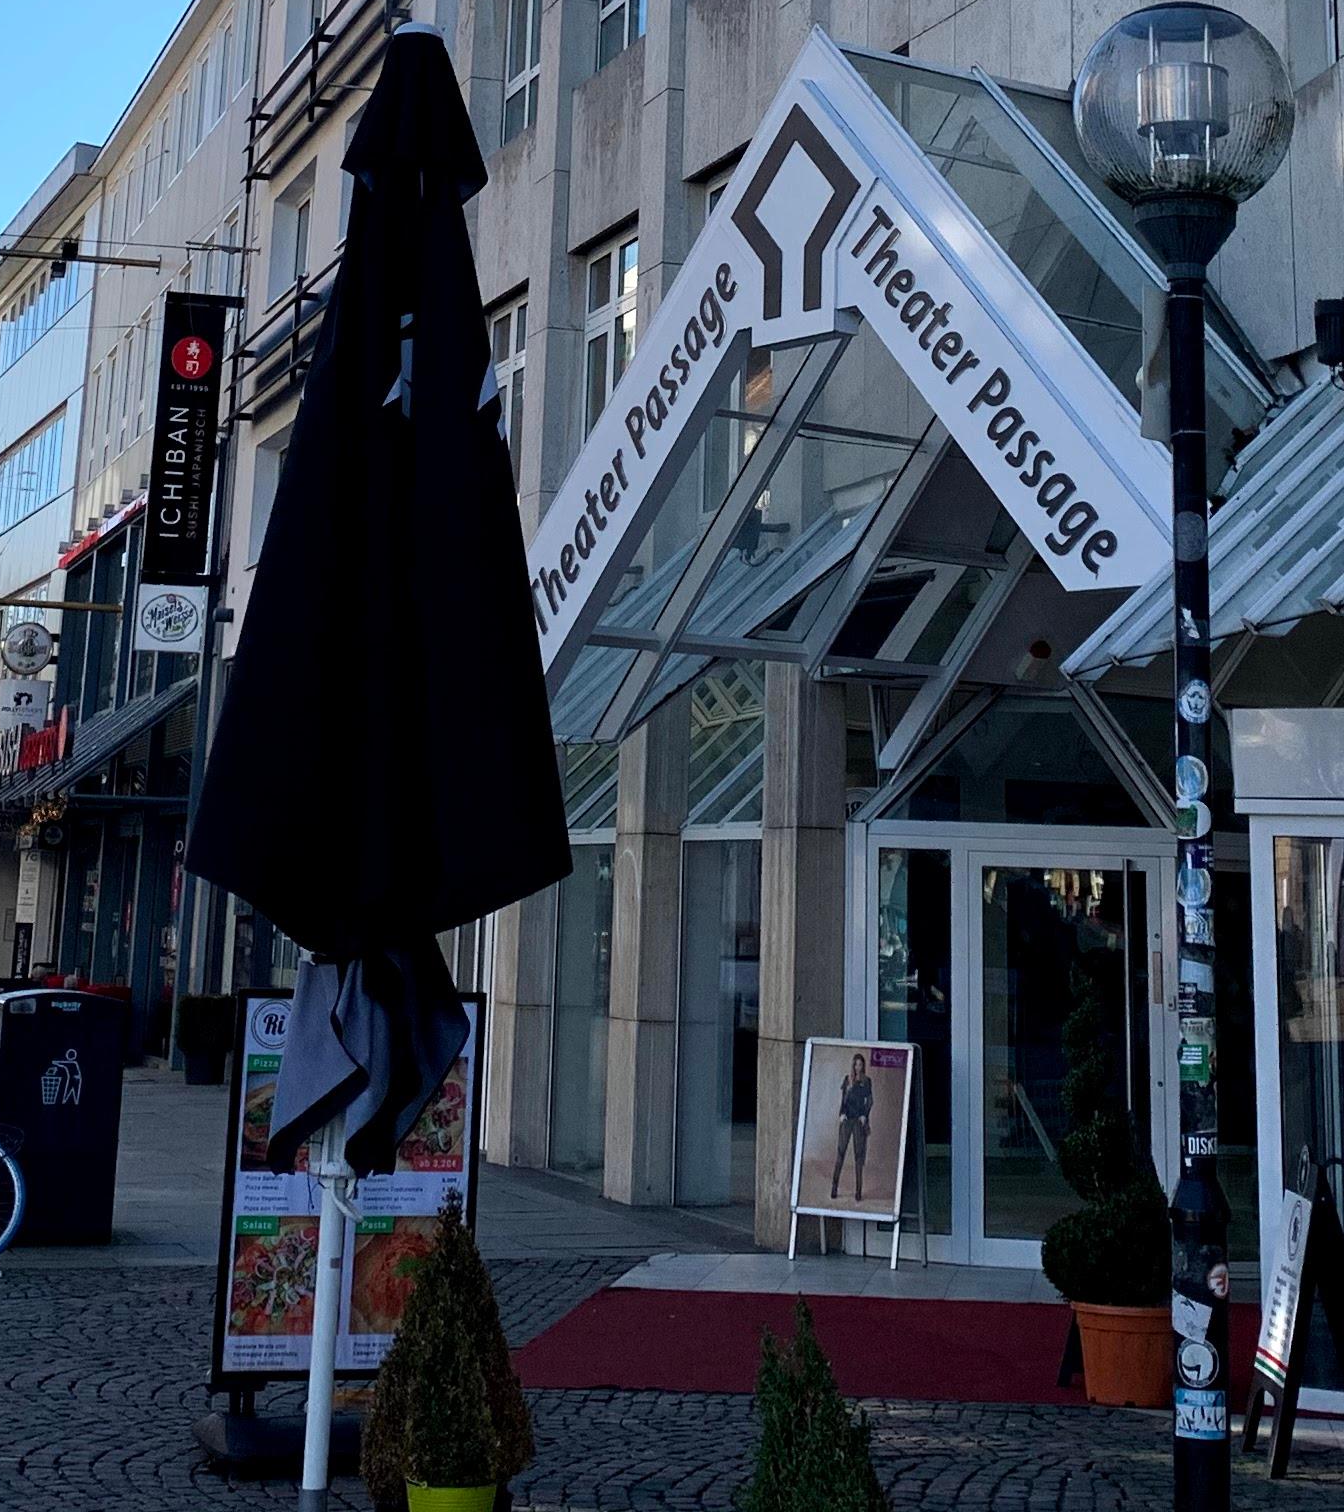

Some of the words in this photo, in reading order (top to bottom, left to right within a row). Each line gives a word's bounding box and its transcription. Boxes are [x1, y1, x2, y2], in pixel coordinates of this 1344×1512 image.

[850, 205, 978, 385] Theater
[969, 368, 1118, 579] Passage
[159, 406, 190, 538] ICHIBAN
[191, 408, 206, 488] JAPANISCH
[531, 449, 628, 635] Theater
[625, 260, 738, 458] Passage
[186, 495, 199, 539] SUSHI
[253, 1058, 279, 1068] Pizza
[361, 1220, 387, 1230] Pasta
